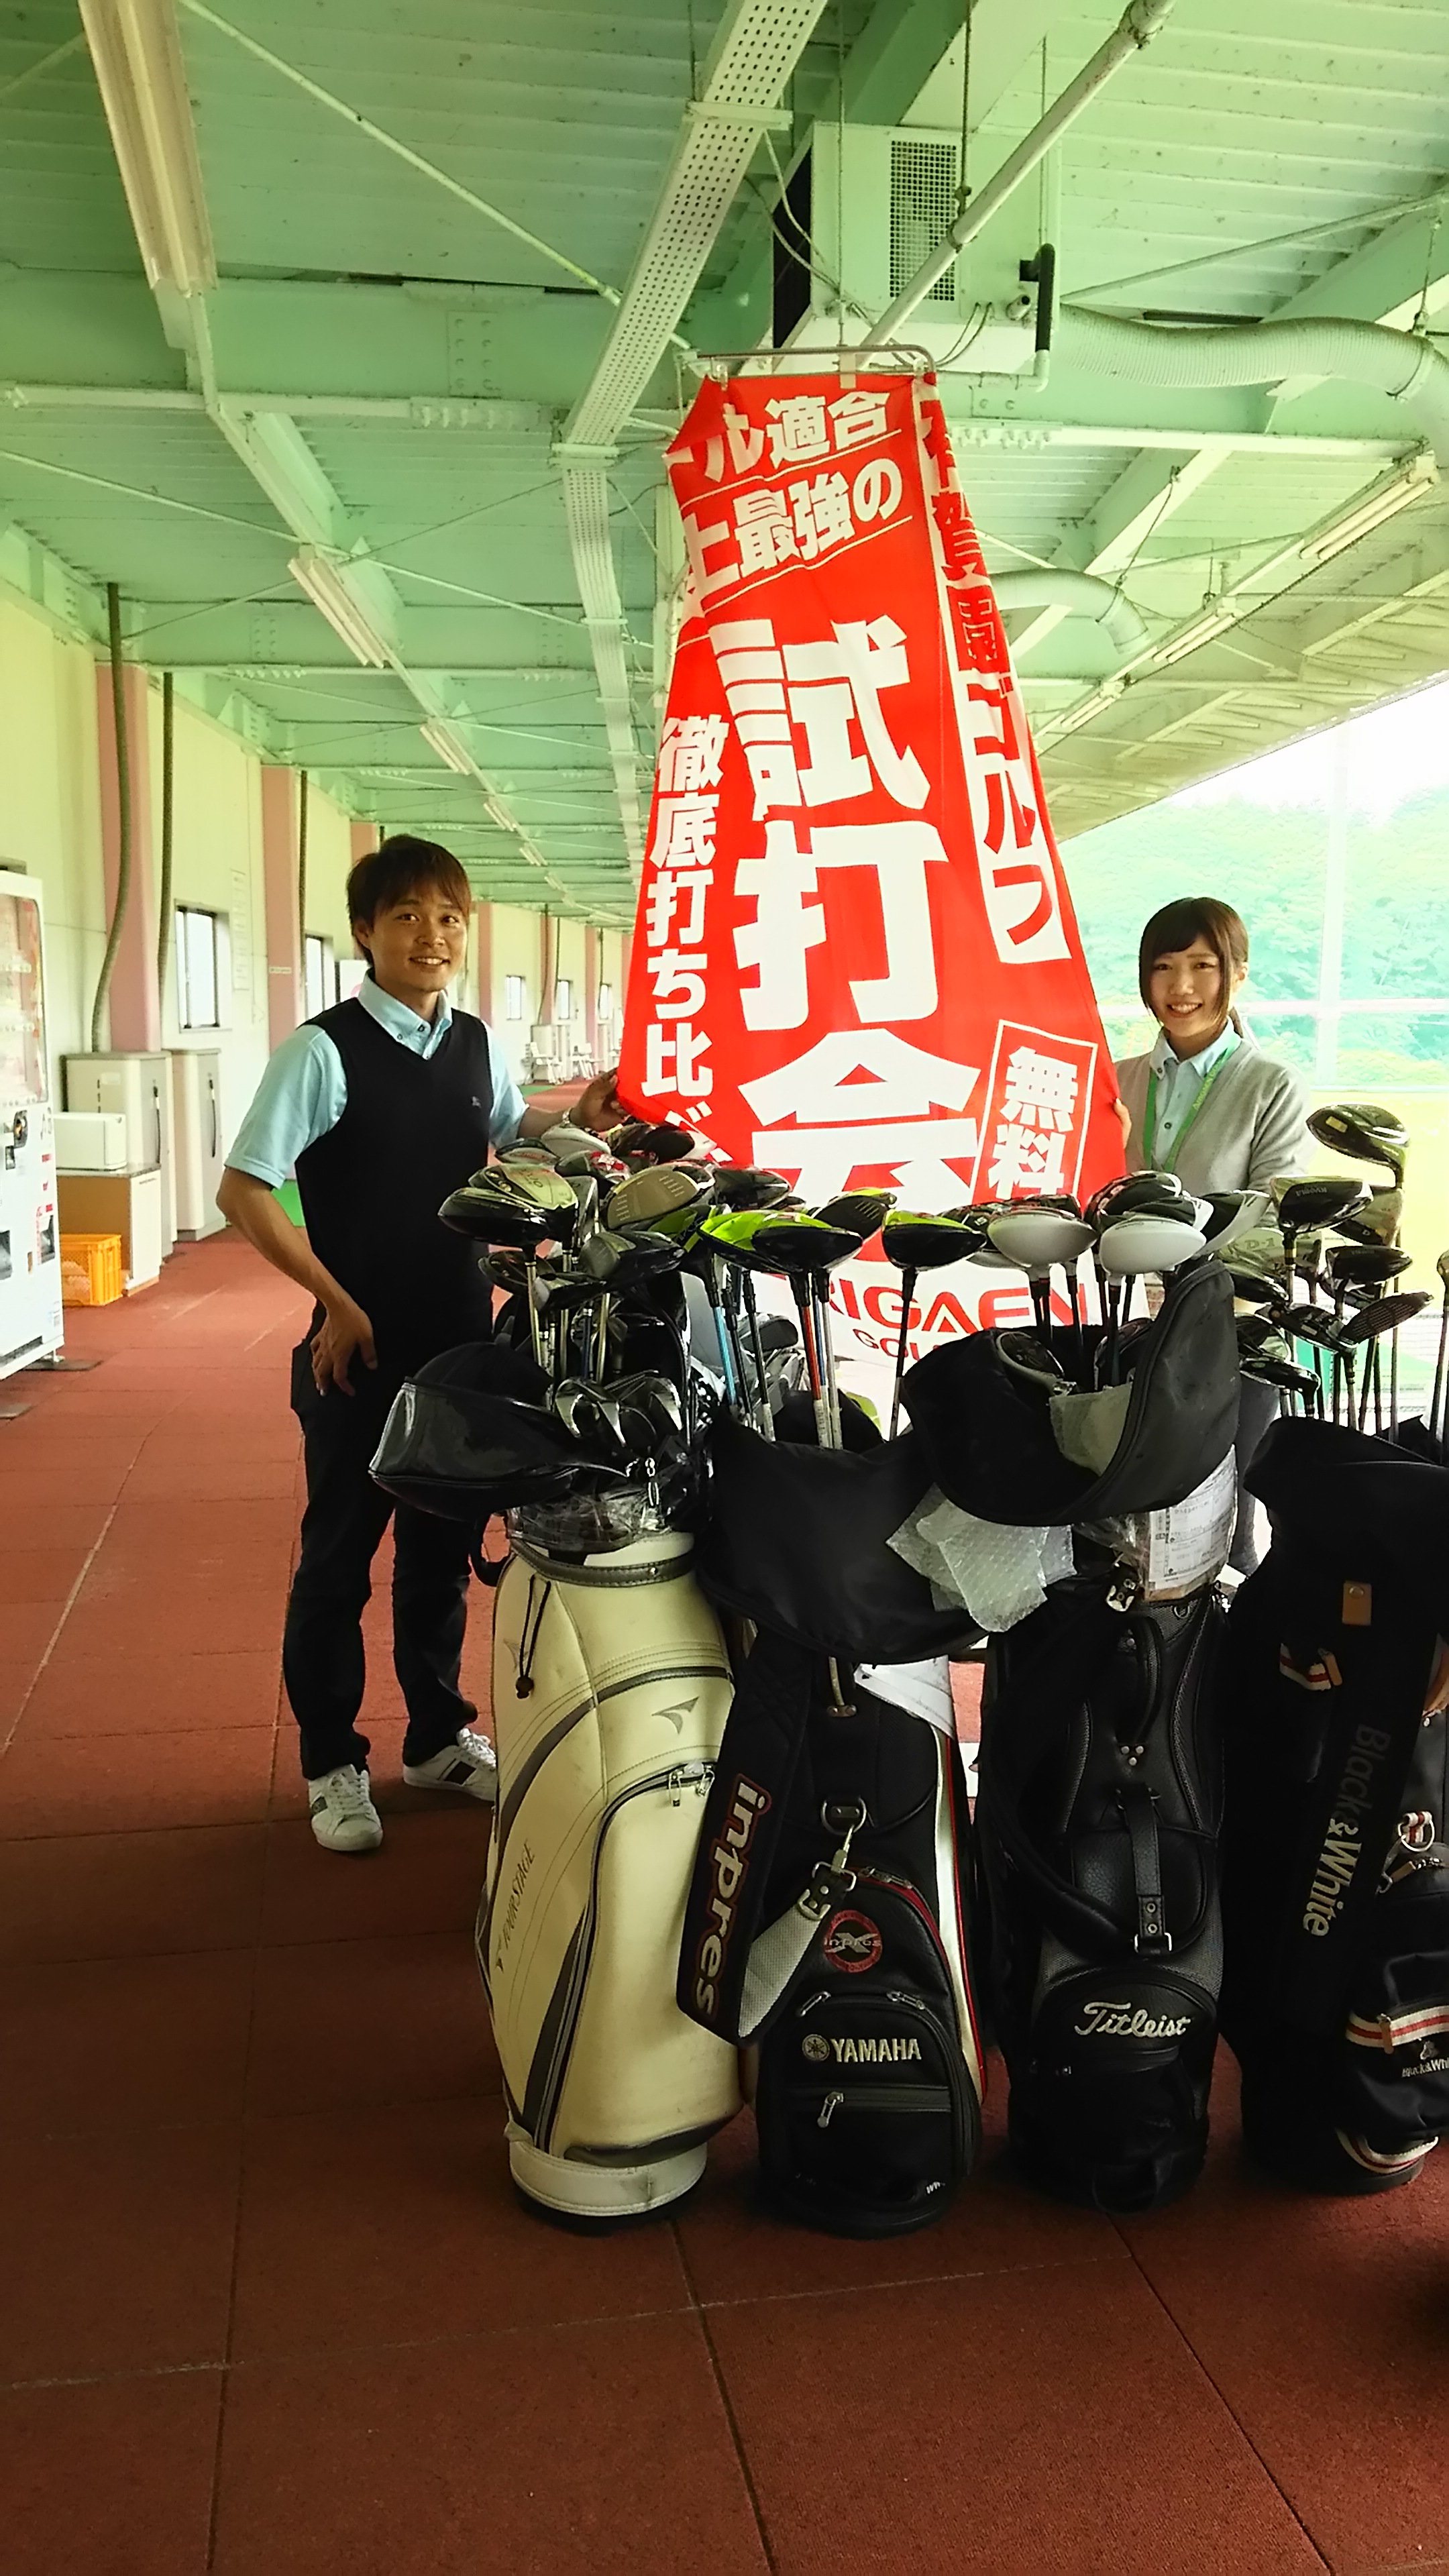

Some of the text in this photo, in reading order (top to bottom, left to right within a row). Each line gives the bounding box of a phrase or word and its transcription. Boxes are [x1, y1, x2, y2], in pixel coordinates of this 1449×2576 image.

[708, 614, 981, 1218] 試打会
[987, 1046, 1079, 1199] 無料
[829, 1278, 1088, 1334] IGAEN
[853, 1329, 941, 1362] GOL
[696, 1781, 766, 2015] inpres
[1074, 2001, 1191, 2037] Titleist
[830, 2037, 922, 2063] YAMAHA
